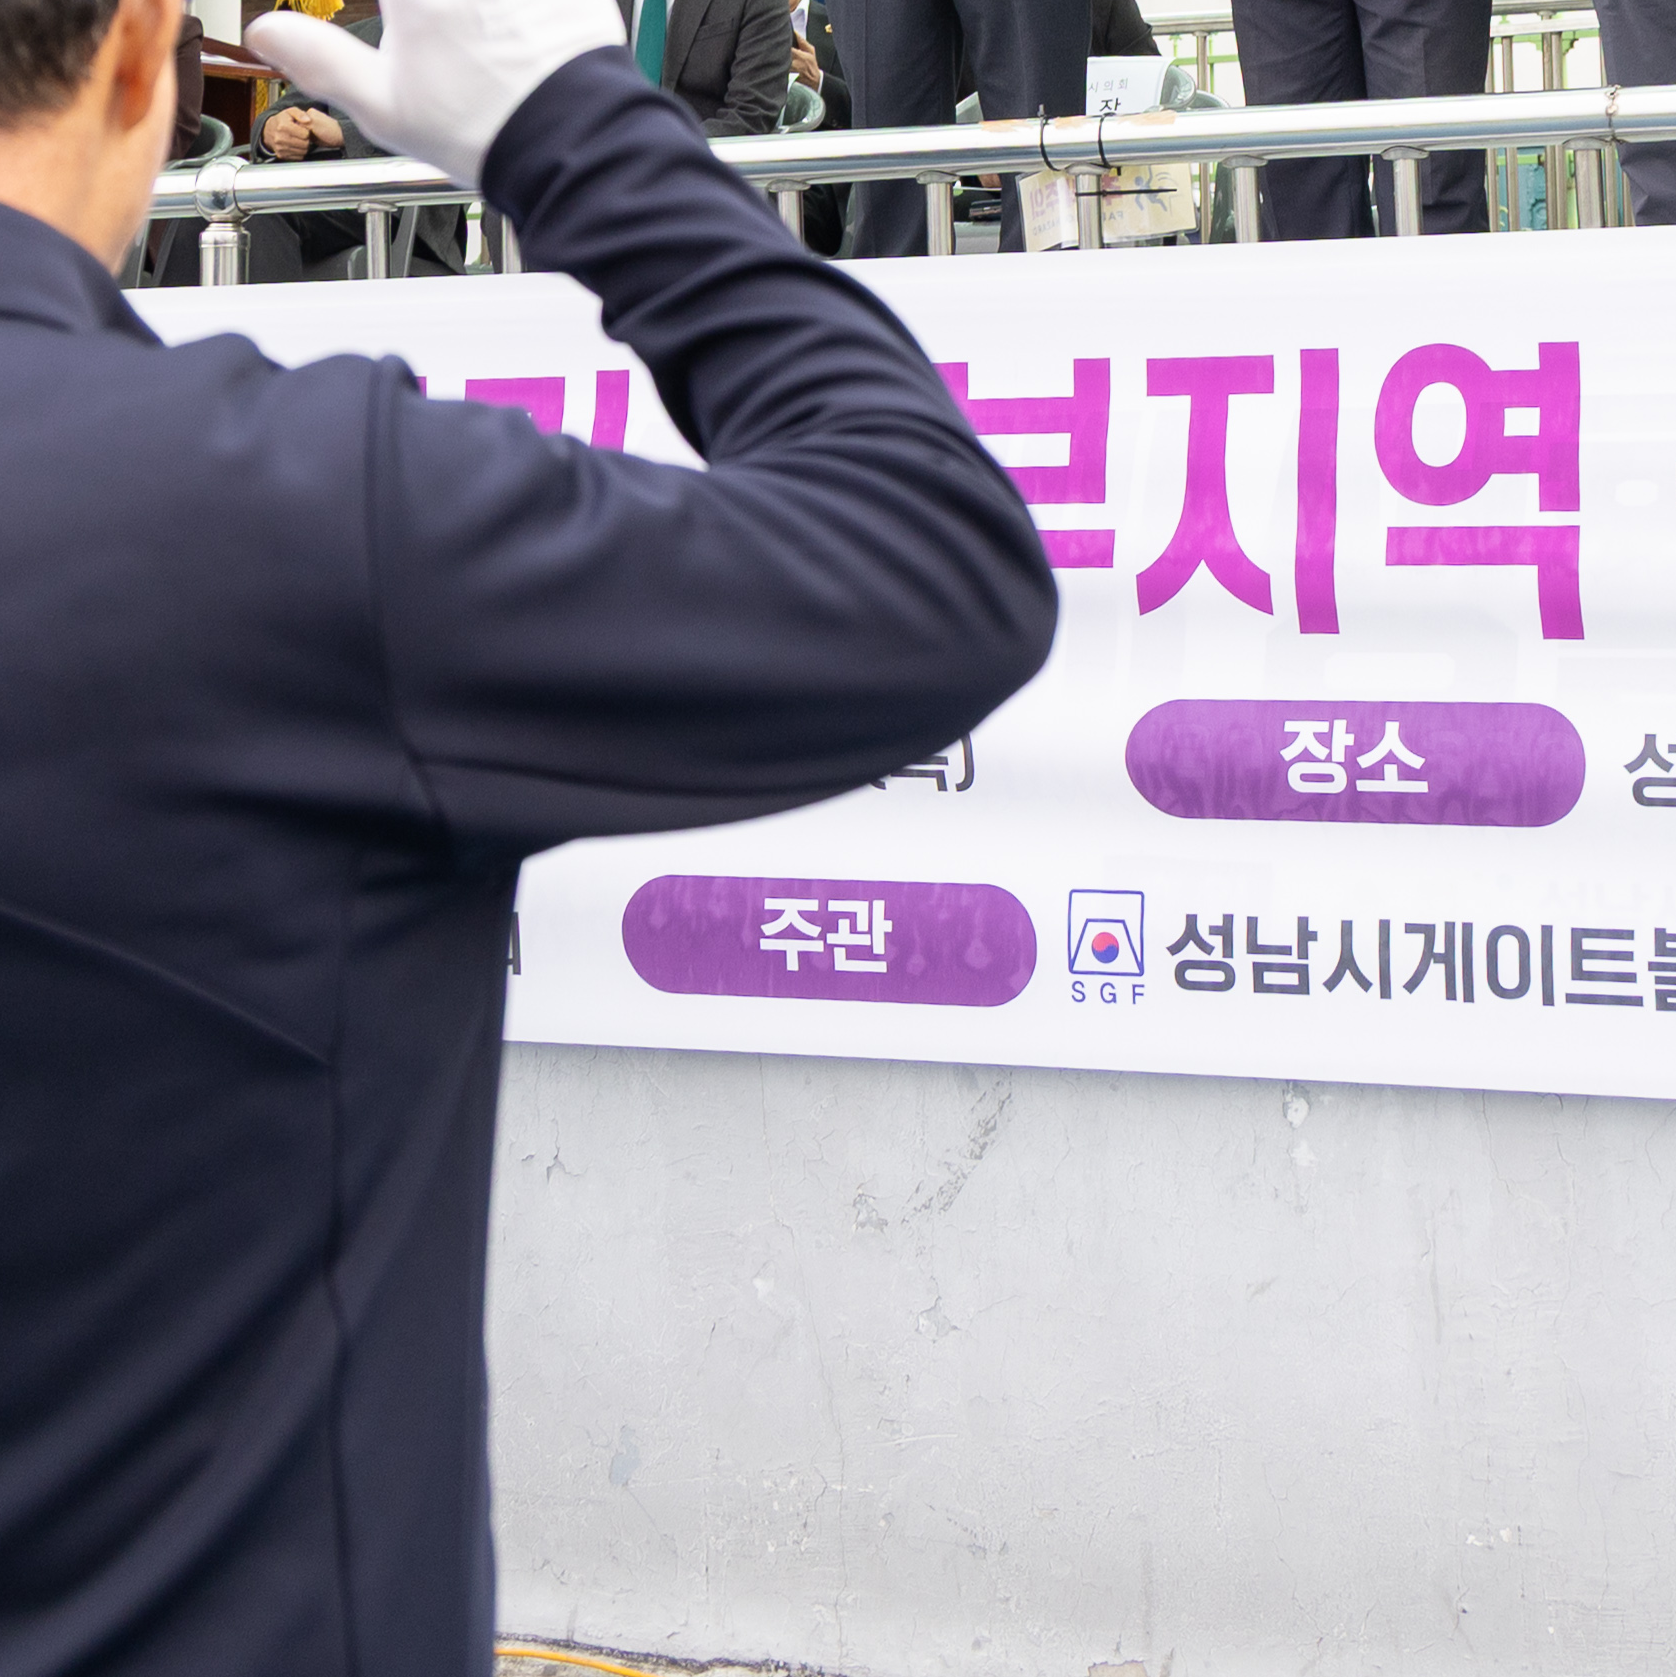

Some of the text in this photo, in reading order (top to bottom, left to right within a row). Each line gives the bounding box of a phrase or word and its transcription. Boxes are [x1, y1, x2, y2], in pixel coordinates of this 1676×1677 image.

[1279, 719, 1429, 794] 장소
[760, 899, 893, 973] 주관
[1070, 981, 1145, 1005] SGF
